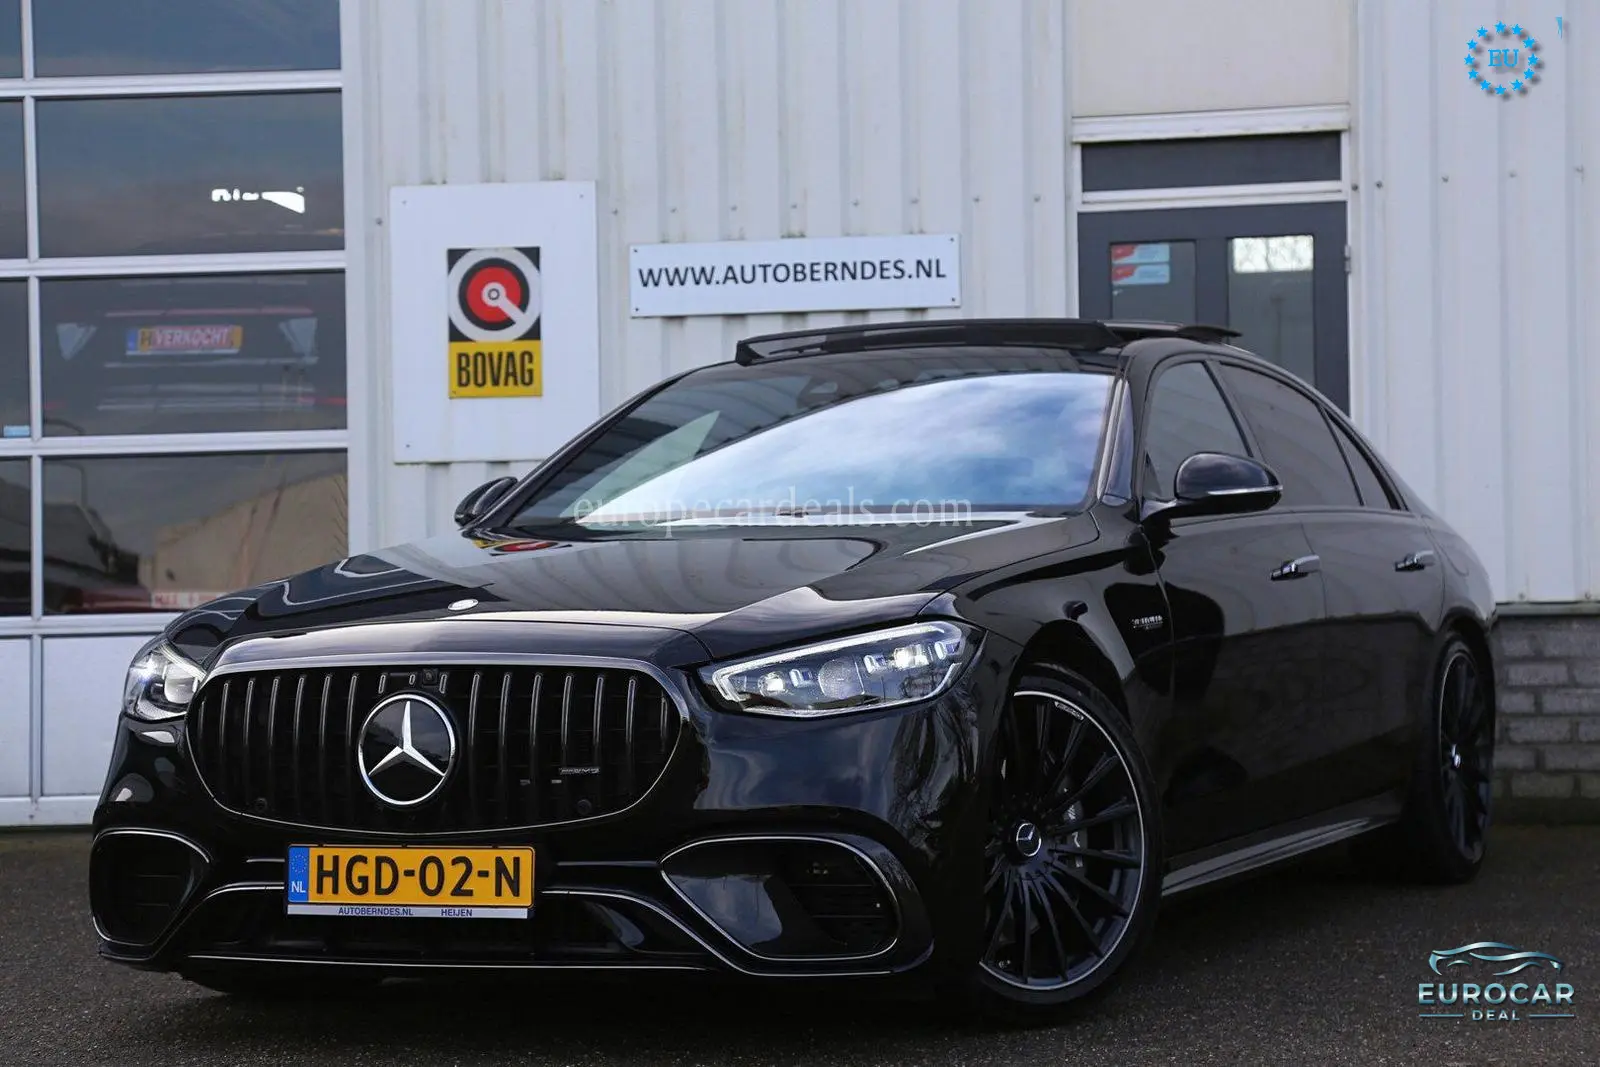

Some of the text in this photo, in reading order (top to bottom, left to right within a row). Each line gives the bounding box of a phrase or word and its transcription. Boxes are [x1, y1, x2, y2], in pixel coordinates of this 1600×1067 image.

[638, 258, 946, 288] WWW.AUTOBERNDES.NL
[155, 327, 229, 347] VERKOCHT
[456, 350, 534, 388] BOVAG
[291, 881, 306, 893] NL
[316, 855, 521, 897] HGD-02-N
[338, 907, 473, 917] AUTOBERNDES.NL HEIJEN
